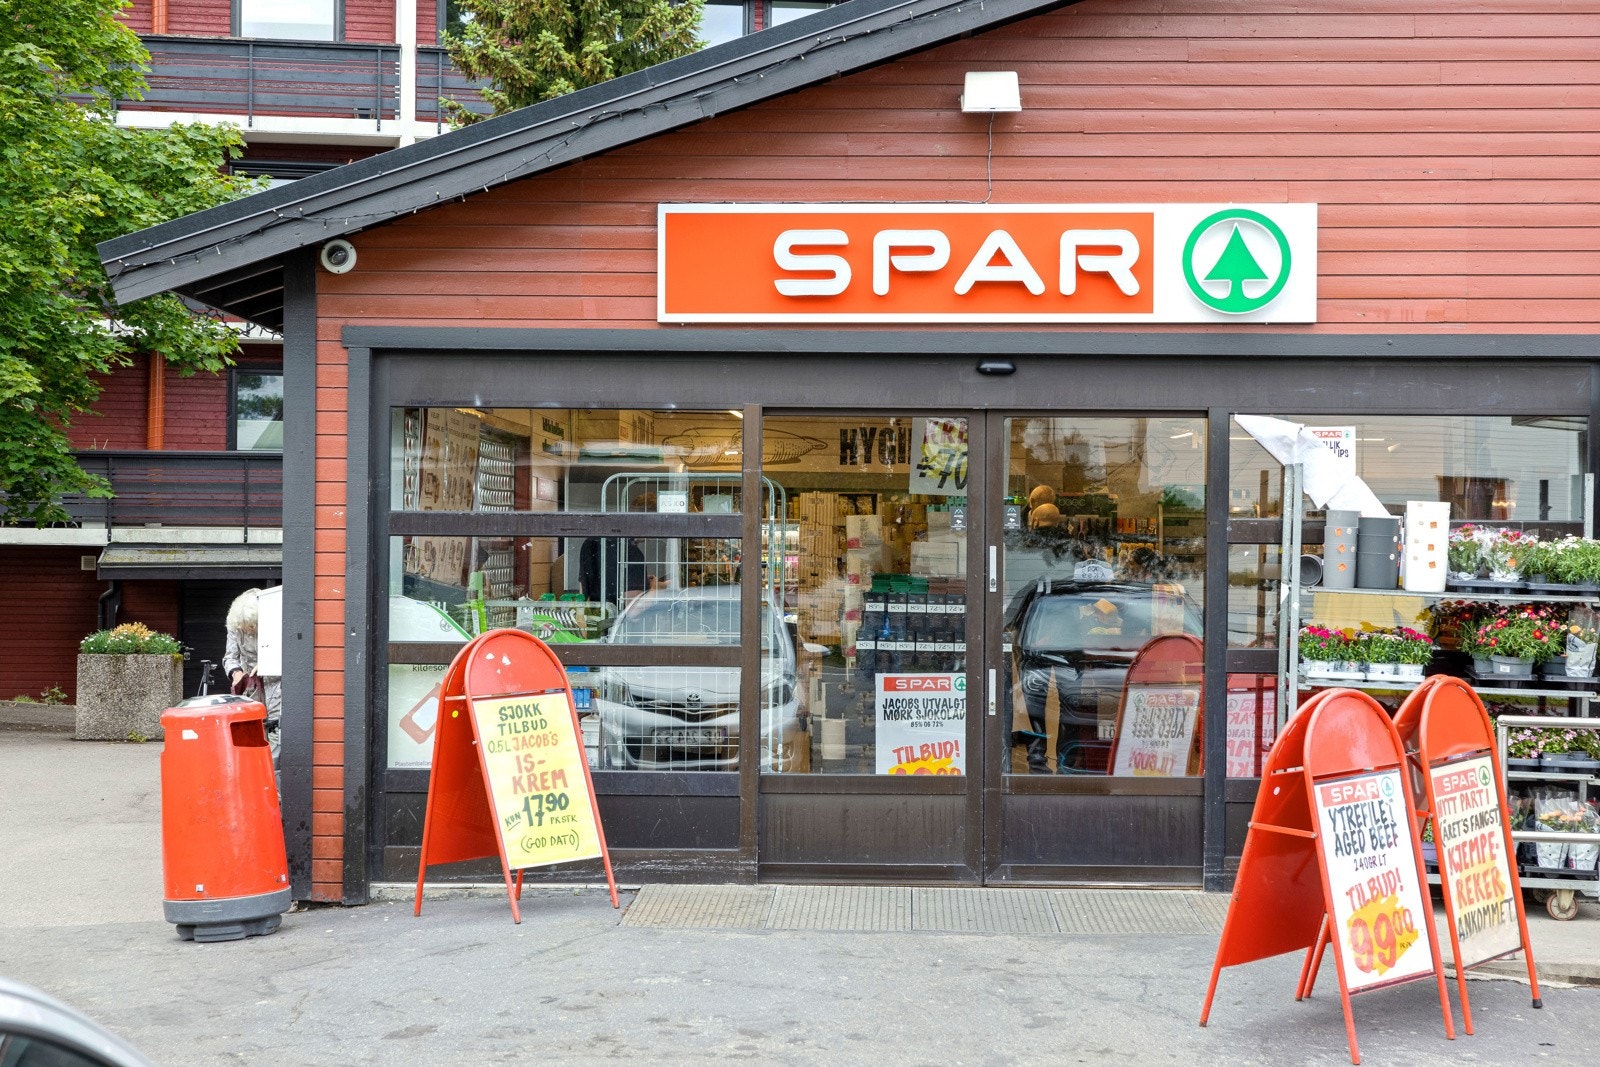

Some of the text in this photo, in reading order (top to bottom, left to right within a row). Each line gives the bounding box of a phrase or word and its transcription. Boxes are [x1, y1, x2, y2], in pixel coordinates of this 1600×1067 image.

[773, 229, 1139, 297] SPAR
[896, 679, 950, 689] SPAR
[498, 703, 542, 721] SJOKK
[883, 698, 919, 709] JACOBS
[883, 709, 913, 721] MØRK
[497, 718, 548, 736] TILBUD
[512, 731, 559, 751] JACOB'S
[892, 740, 960, 764] TILBUD!
[515, 753, 546, 774] IS-
[512, 769, 569, 795] KREM
[1331, 781, 1378, 802] SPAR
[1443, 771, 1478, 792] SPAR
[1459, 788, 1490, 812] PARTI
[505, 811, 522, 827] KUN
[550, 829, 580, 851] DATO)
[1335, 822, 1398, 858] AGED BEEF
[1345, 867, 1404, 912] TILBUD!
[1456, 866, 1506, 909] REKER
[1458, 897, 1514, 941] ANKOMMET
